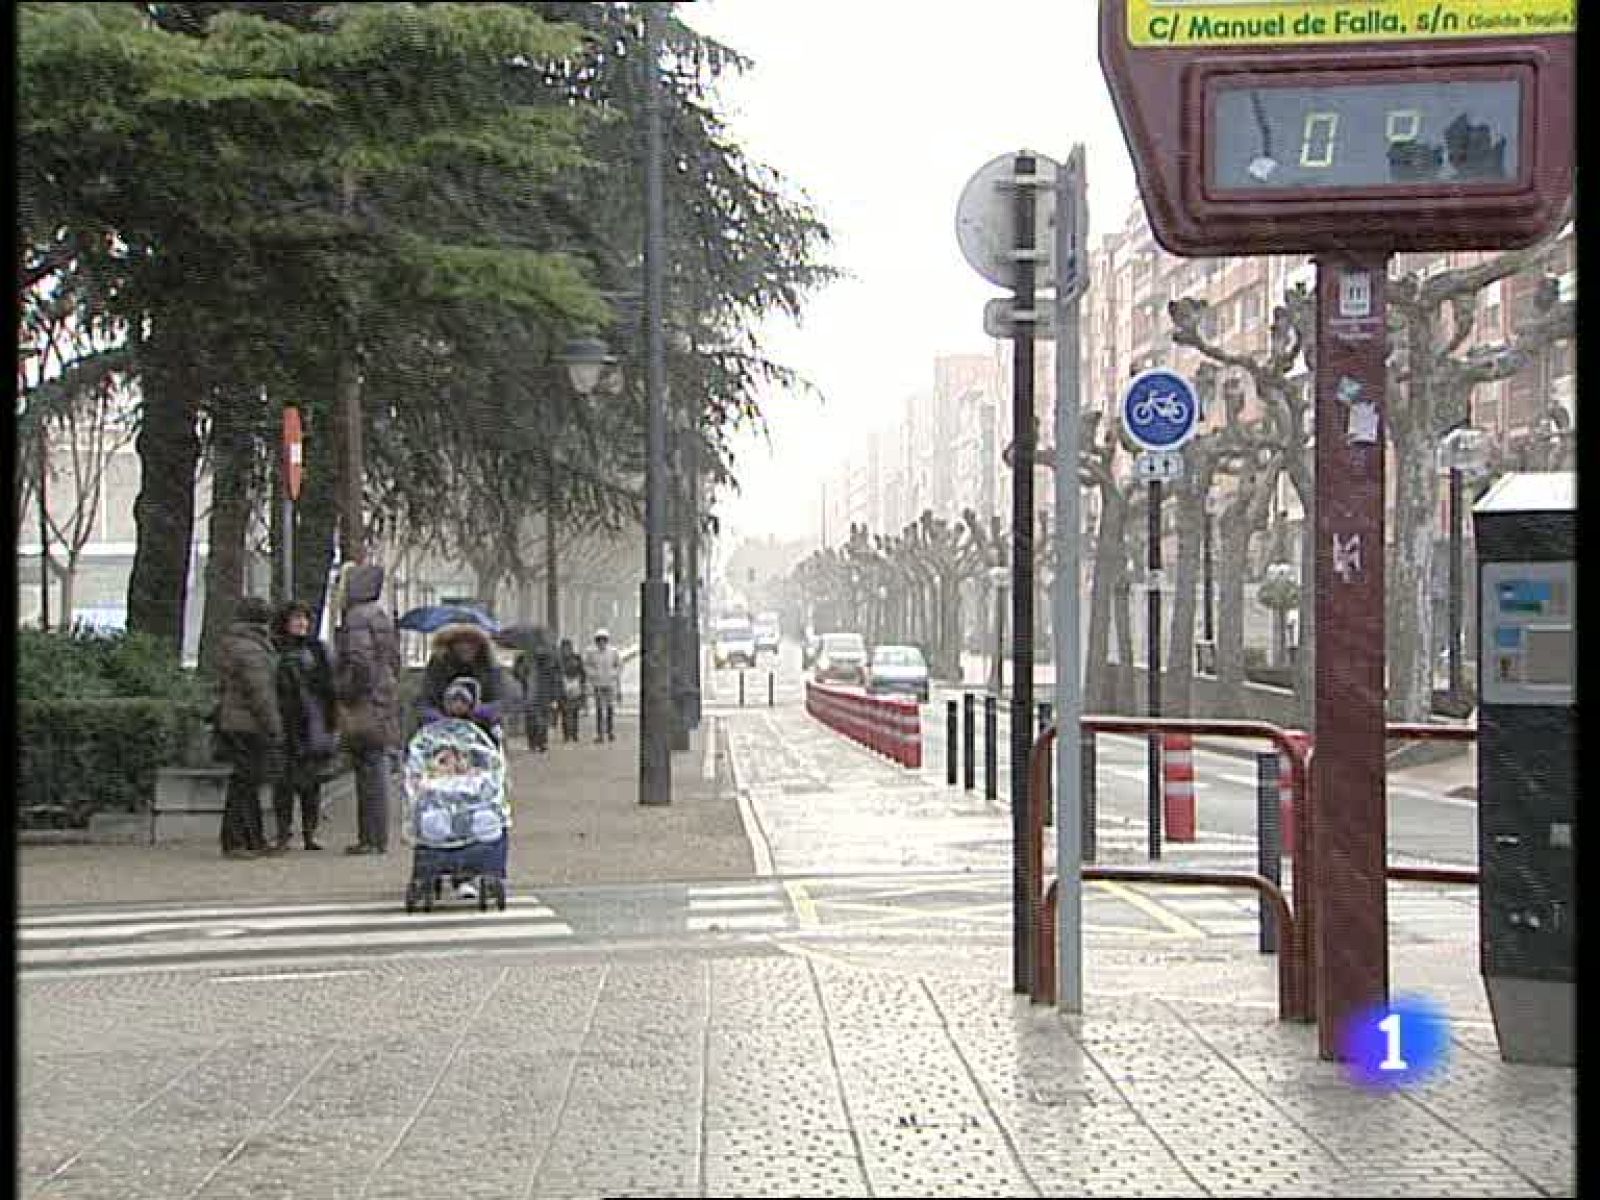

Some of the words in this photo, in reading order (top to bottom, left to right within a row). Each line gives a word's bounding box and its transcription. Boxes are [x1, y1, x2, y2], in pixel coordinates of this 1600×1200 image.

[1149, 12, 1180, 42] C/
[1188, 13, 1285, 39] Manuel
[1293, 12, 1326, 34] de
[1416, 3, 1458, 33] s/n
[1300, 112, 1338, 168] 0
